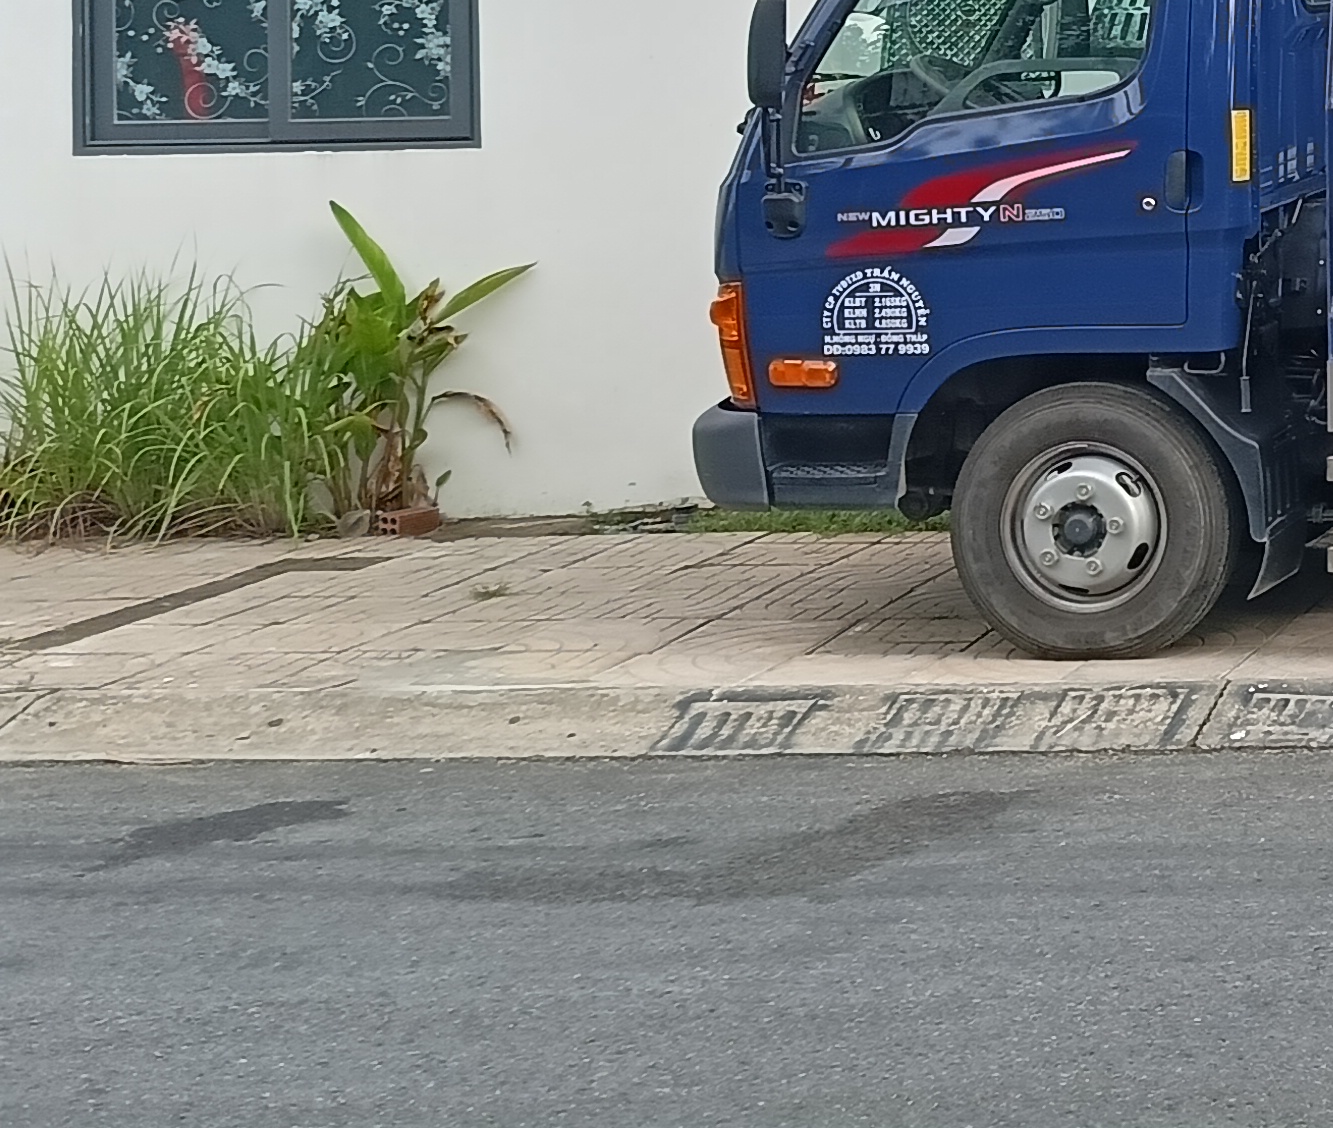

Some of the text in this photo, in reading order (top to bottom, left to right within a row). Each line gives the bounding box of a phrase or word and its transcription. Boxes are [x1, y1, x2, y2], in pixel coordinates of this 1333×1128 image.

[837, 212, 870, 222] NEW
[871, 205, 997, 227] MIGHTY
[879, 344, 895, 355] 77
[898, 343, 930, 354] 9939
